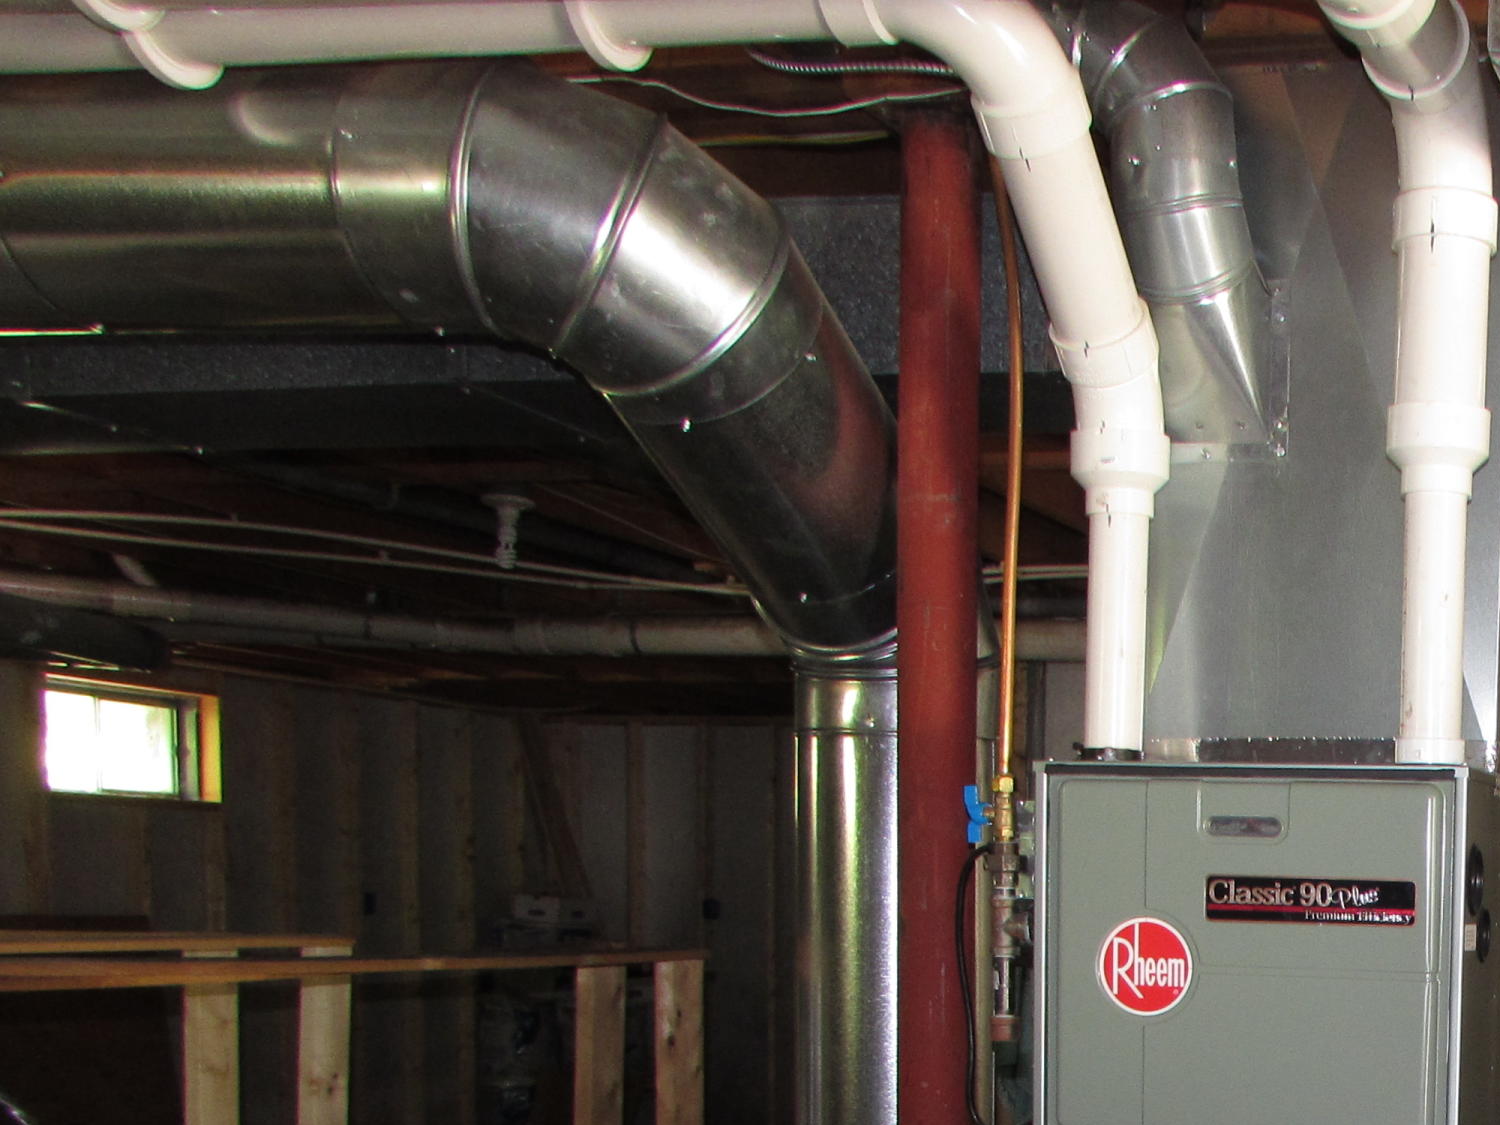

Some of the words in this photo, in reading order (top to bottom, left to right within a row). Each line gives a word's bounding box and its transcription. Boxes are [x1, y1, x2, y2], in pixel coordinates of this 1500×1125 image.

[1208, 879, 1294, 905] Classic
[1300, 882, 1331, 907] 90
[1331, 886, 1379, 909] Plus
[1304, 910, 1355, 921] Premium
[1113, 922, 1185, 999] Rheem
